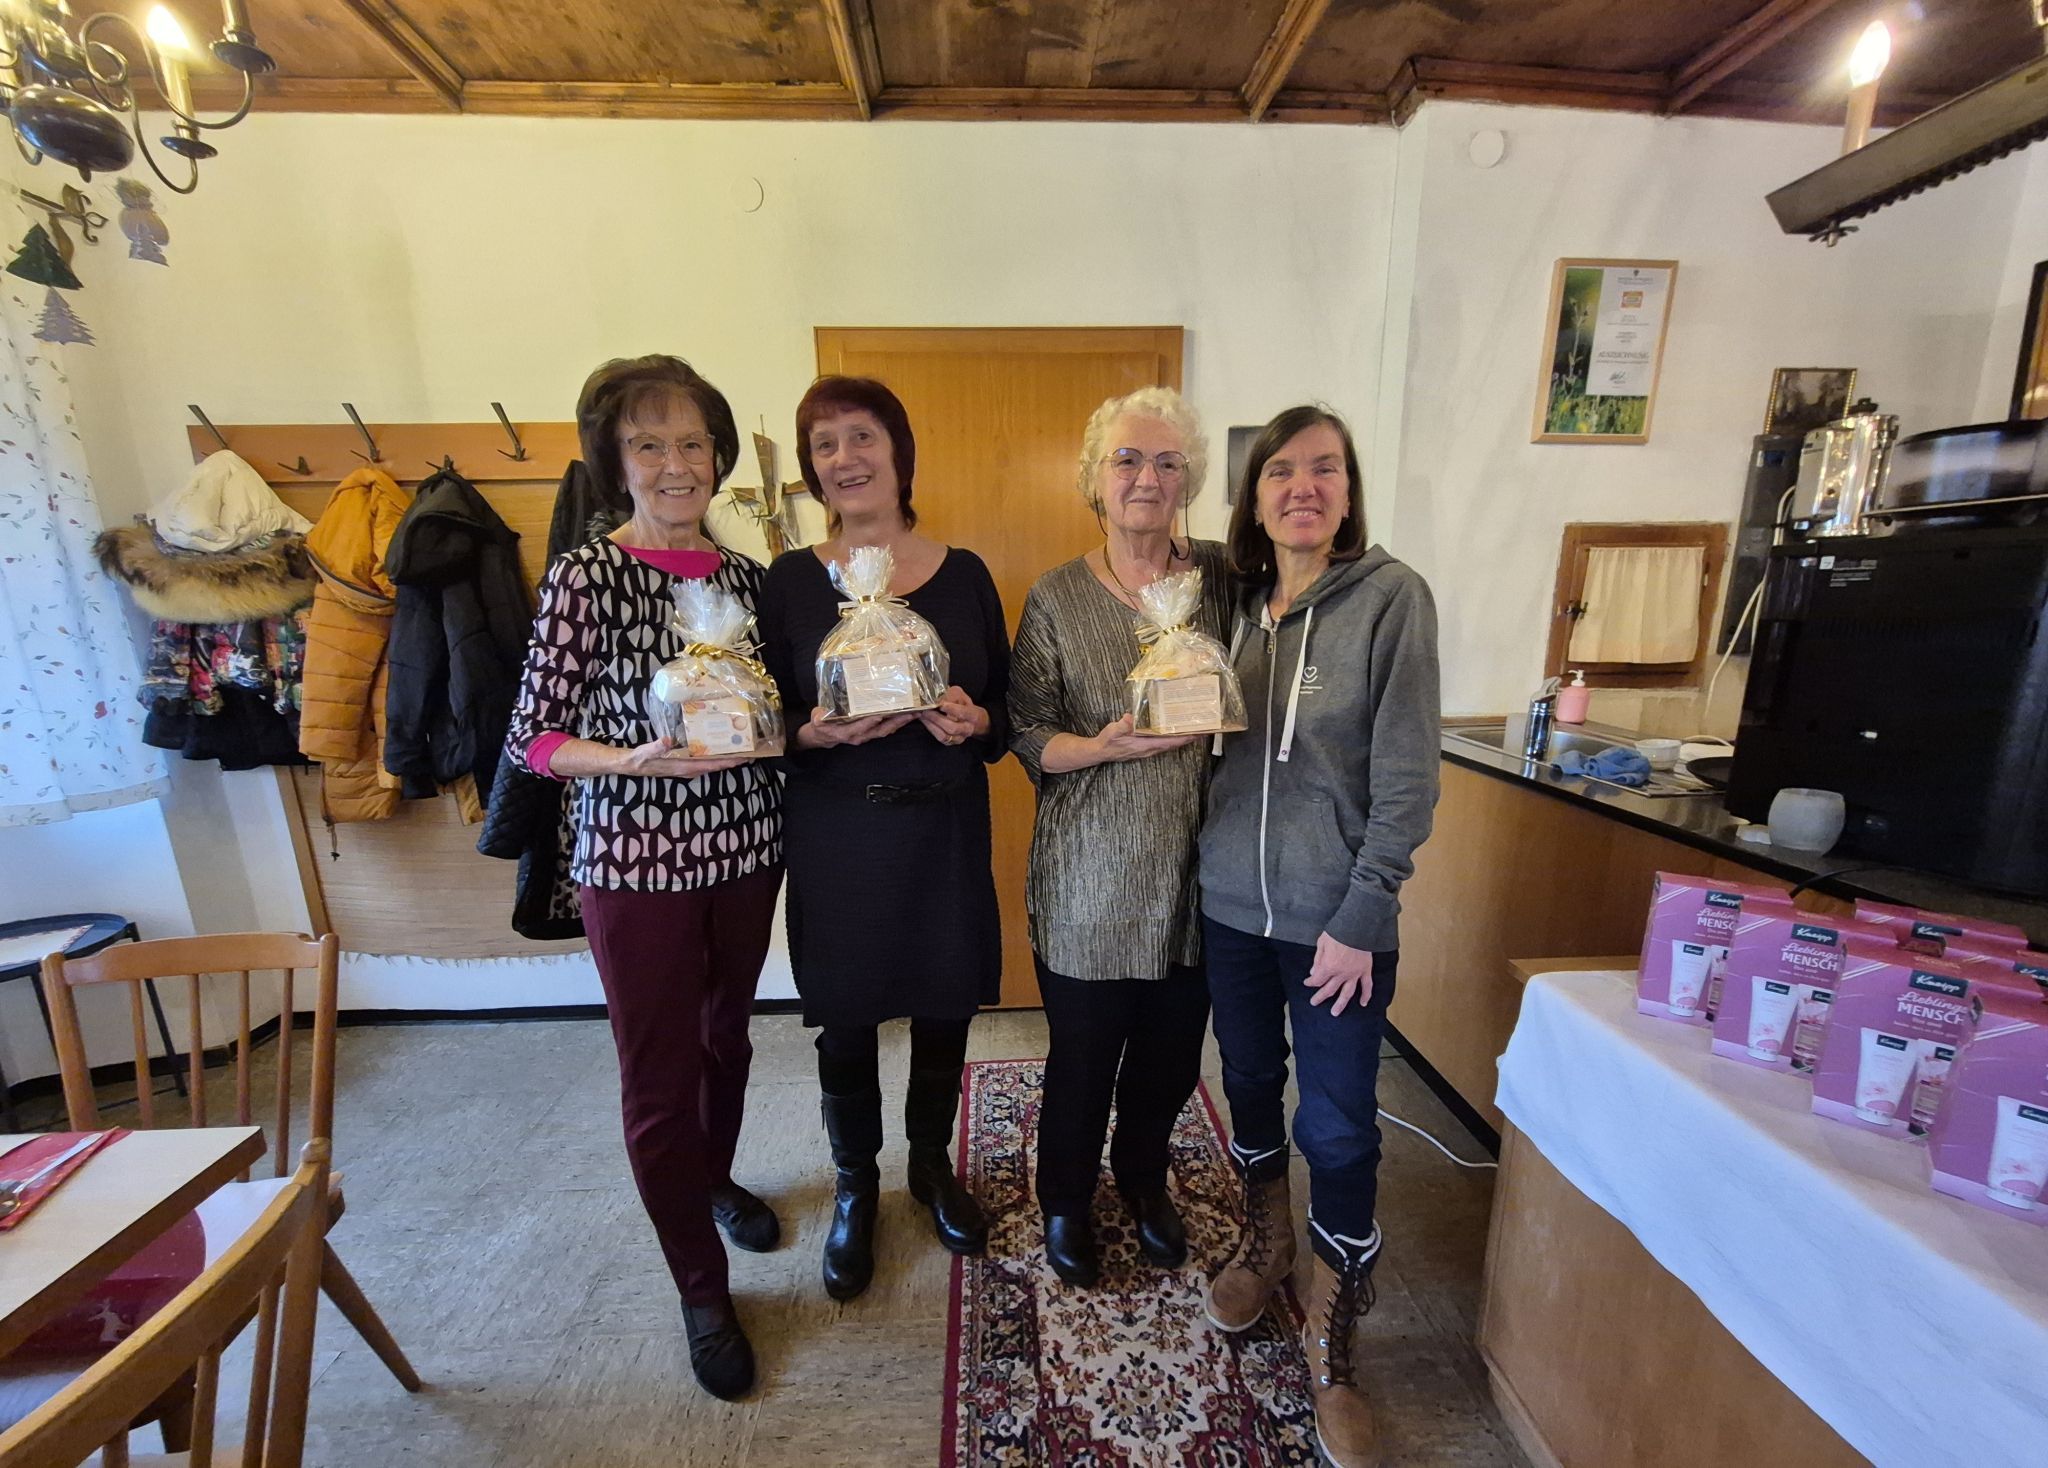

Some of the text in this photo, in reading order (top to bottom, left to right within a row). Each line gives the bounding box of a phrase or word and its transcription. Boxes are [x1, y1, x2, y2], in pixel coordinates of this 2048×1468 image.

[1697, 916, 1735, 930] MENSC
[1797, 927, 1833, 942] Kneipp
[1781, 951, 1838, 971] MENSCH
[1915, 974, 1961, 992] Kneipp
